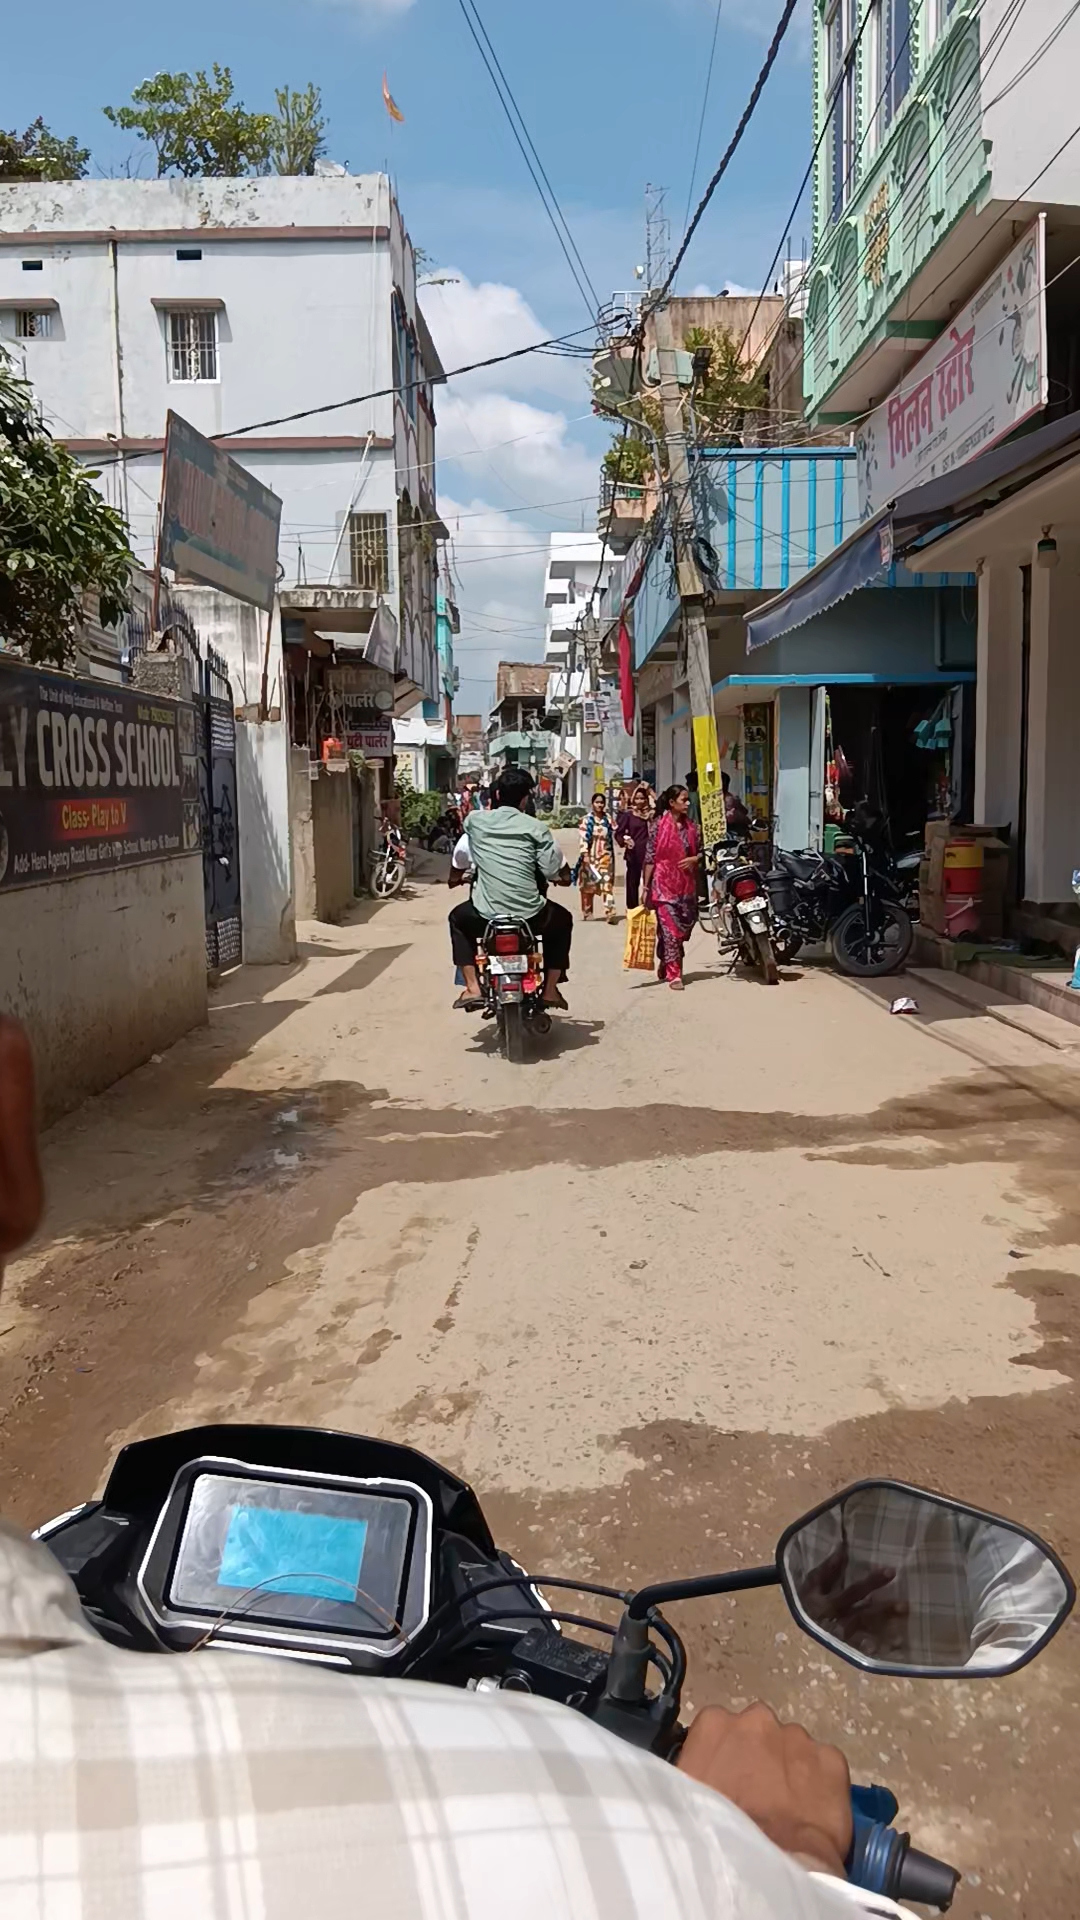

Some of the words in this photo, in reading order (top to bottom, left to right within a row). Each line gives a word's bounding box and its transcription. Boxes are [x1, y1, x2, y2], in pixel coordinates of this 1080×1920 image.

[888, 374, 934, 470] मिलन
[935, 325, 976, 422] स्टोर
[36, 709, 111, 787] CROSS
[114, 720, 180, 787] SCHOOL
[62, 804, 90, 830] Class-
[91, 803, 110, 831] Play
[111, 803, 120, 825] to
[120, 802, 127, 824] V
[31, 852, 47, 870] Hero
[48, 849, 70, 873] Agency
[70, 846, 85, 864] Road
[85, 843, 98, 861] Near
